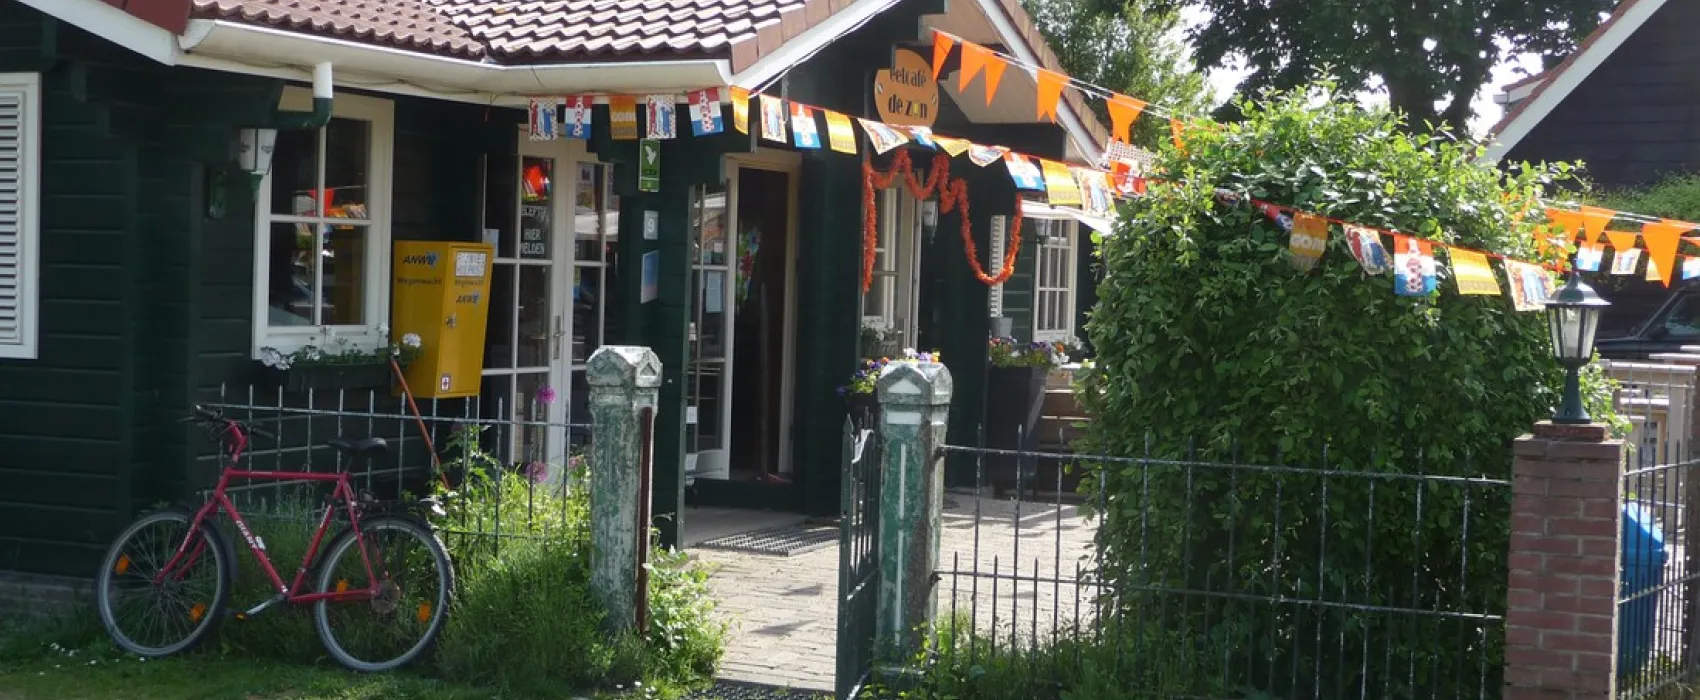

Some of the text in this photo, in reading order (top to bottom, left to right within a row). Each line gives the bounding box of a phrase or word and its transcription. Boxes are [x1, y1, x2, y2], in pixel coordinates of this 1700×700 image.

[888, 94, 927, 118] de zon
[524, 229, 541, 240] HIER
[402, 253, 437, 266] ANWB
